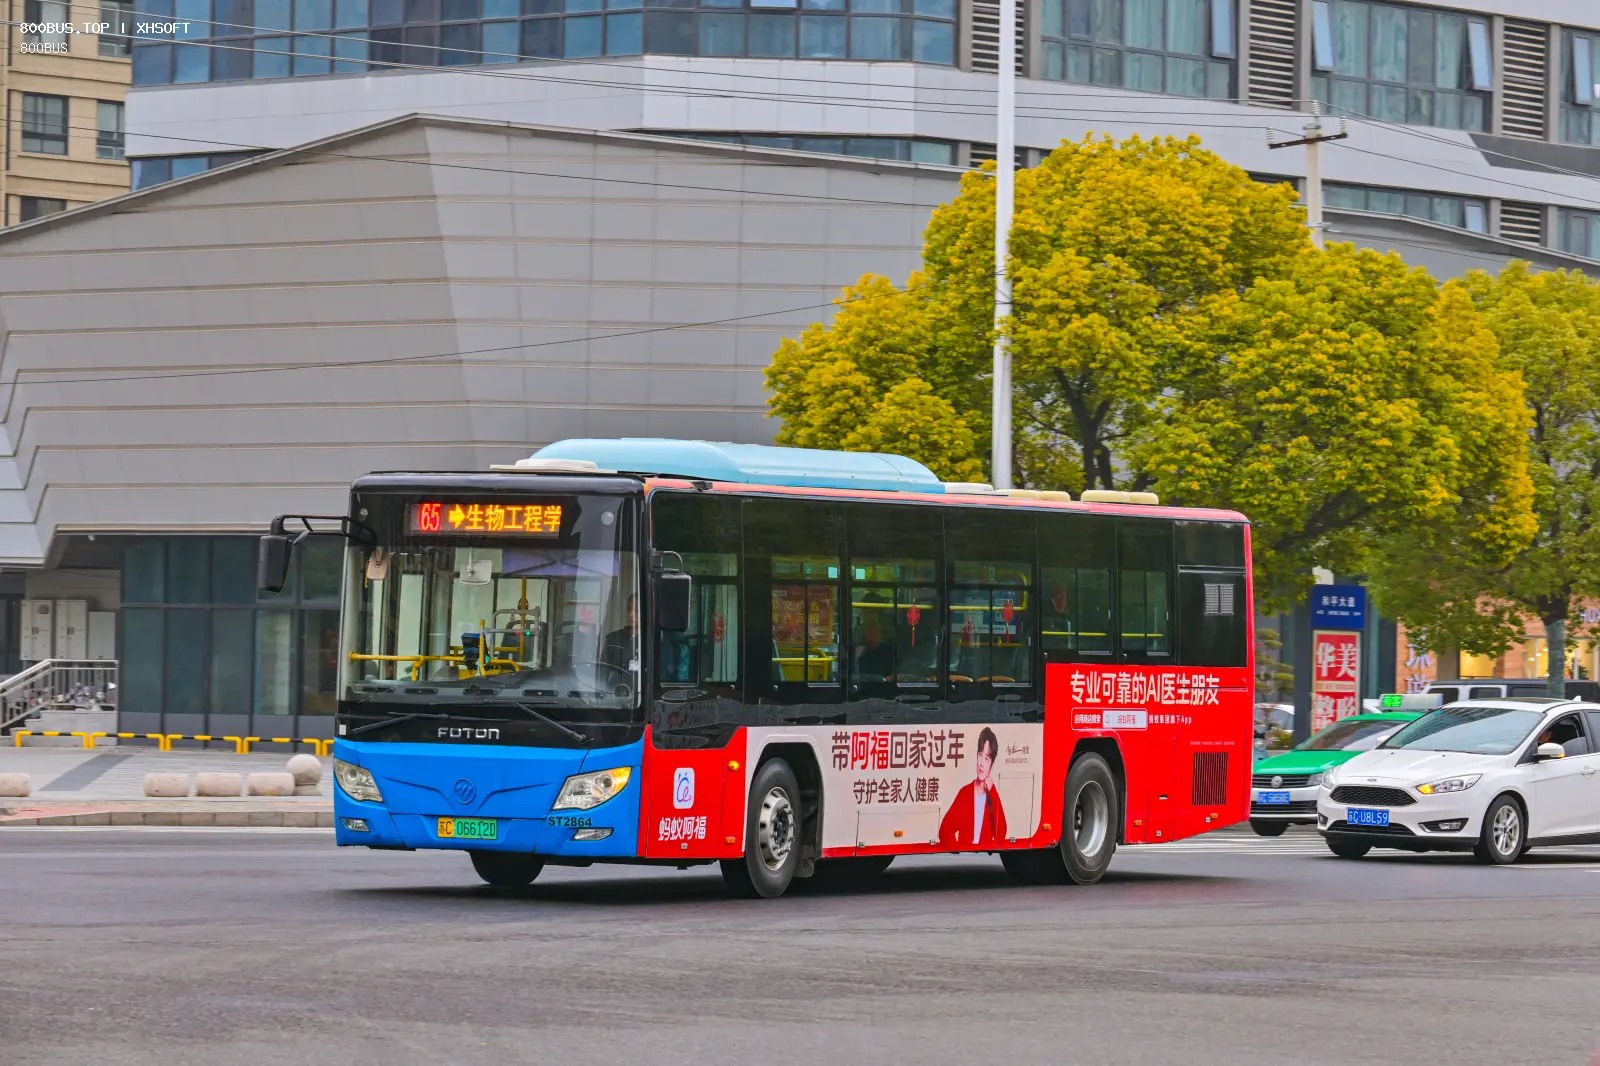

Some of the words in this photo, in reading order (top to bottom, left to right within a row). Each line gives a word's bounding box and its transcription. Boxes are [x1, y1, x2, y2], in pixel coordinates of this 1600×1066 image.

[420, 503, 442, 531] 65
[465, 504, 562, 532] 生物工程学
[1316, 642, 1357, 678] 华美
[1070, 670, 1220, 706] 专业可靠的AI医生朋友
[437, 727, 500, 740] FOTON
[831, 729, 965, 771] 带阿福回家过年
[853, 777, 940, 805] 守护全家人健康
[548, 816, 593, 828] ST2864
[658, 815, 708, 841] 蚂蚁阿福
